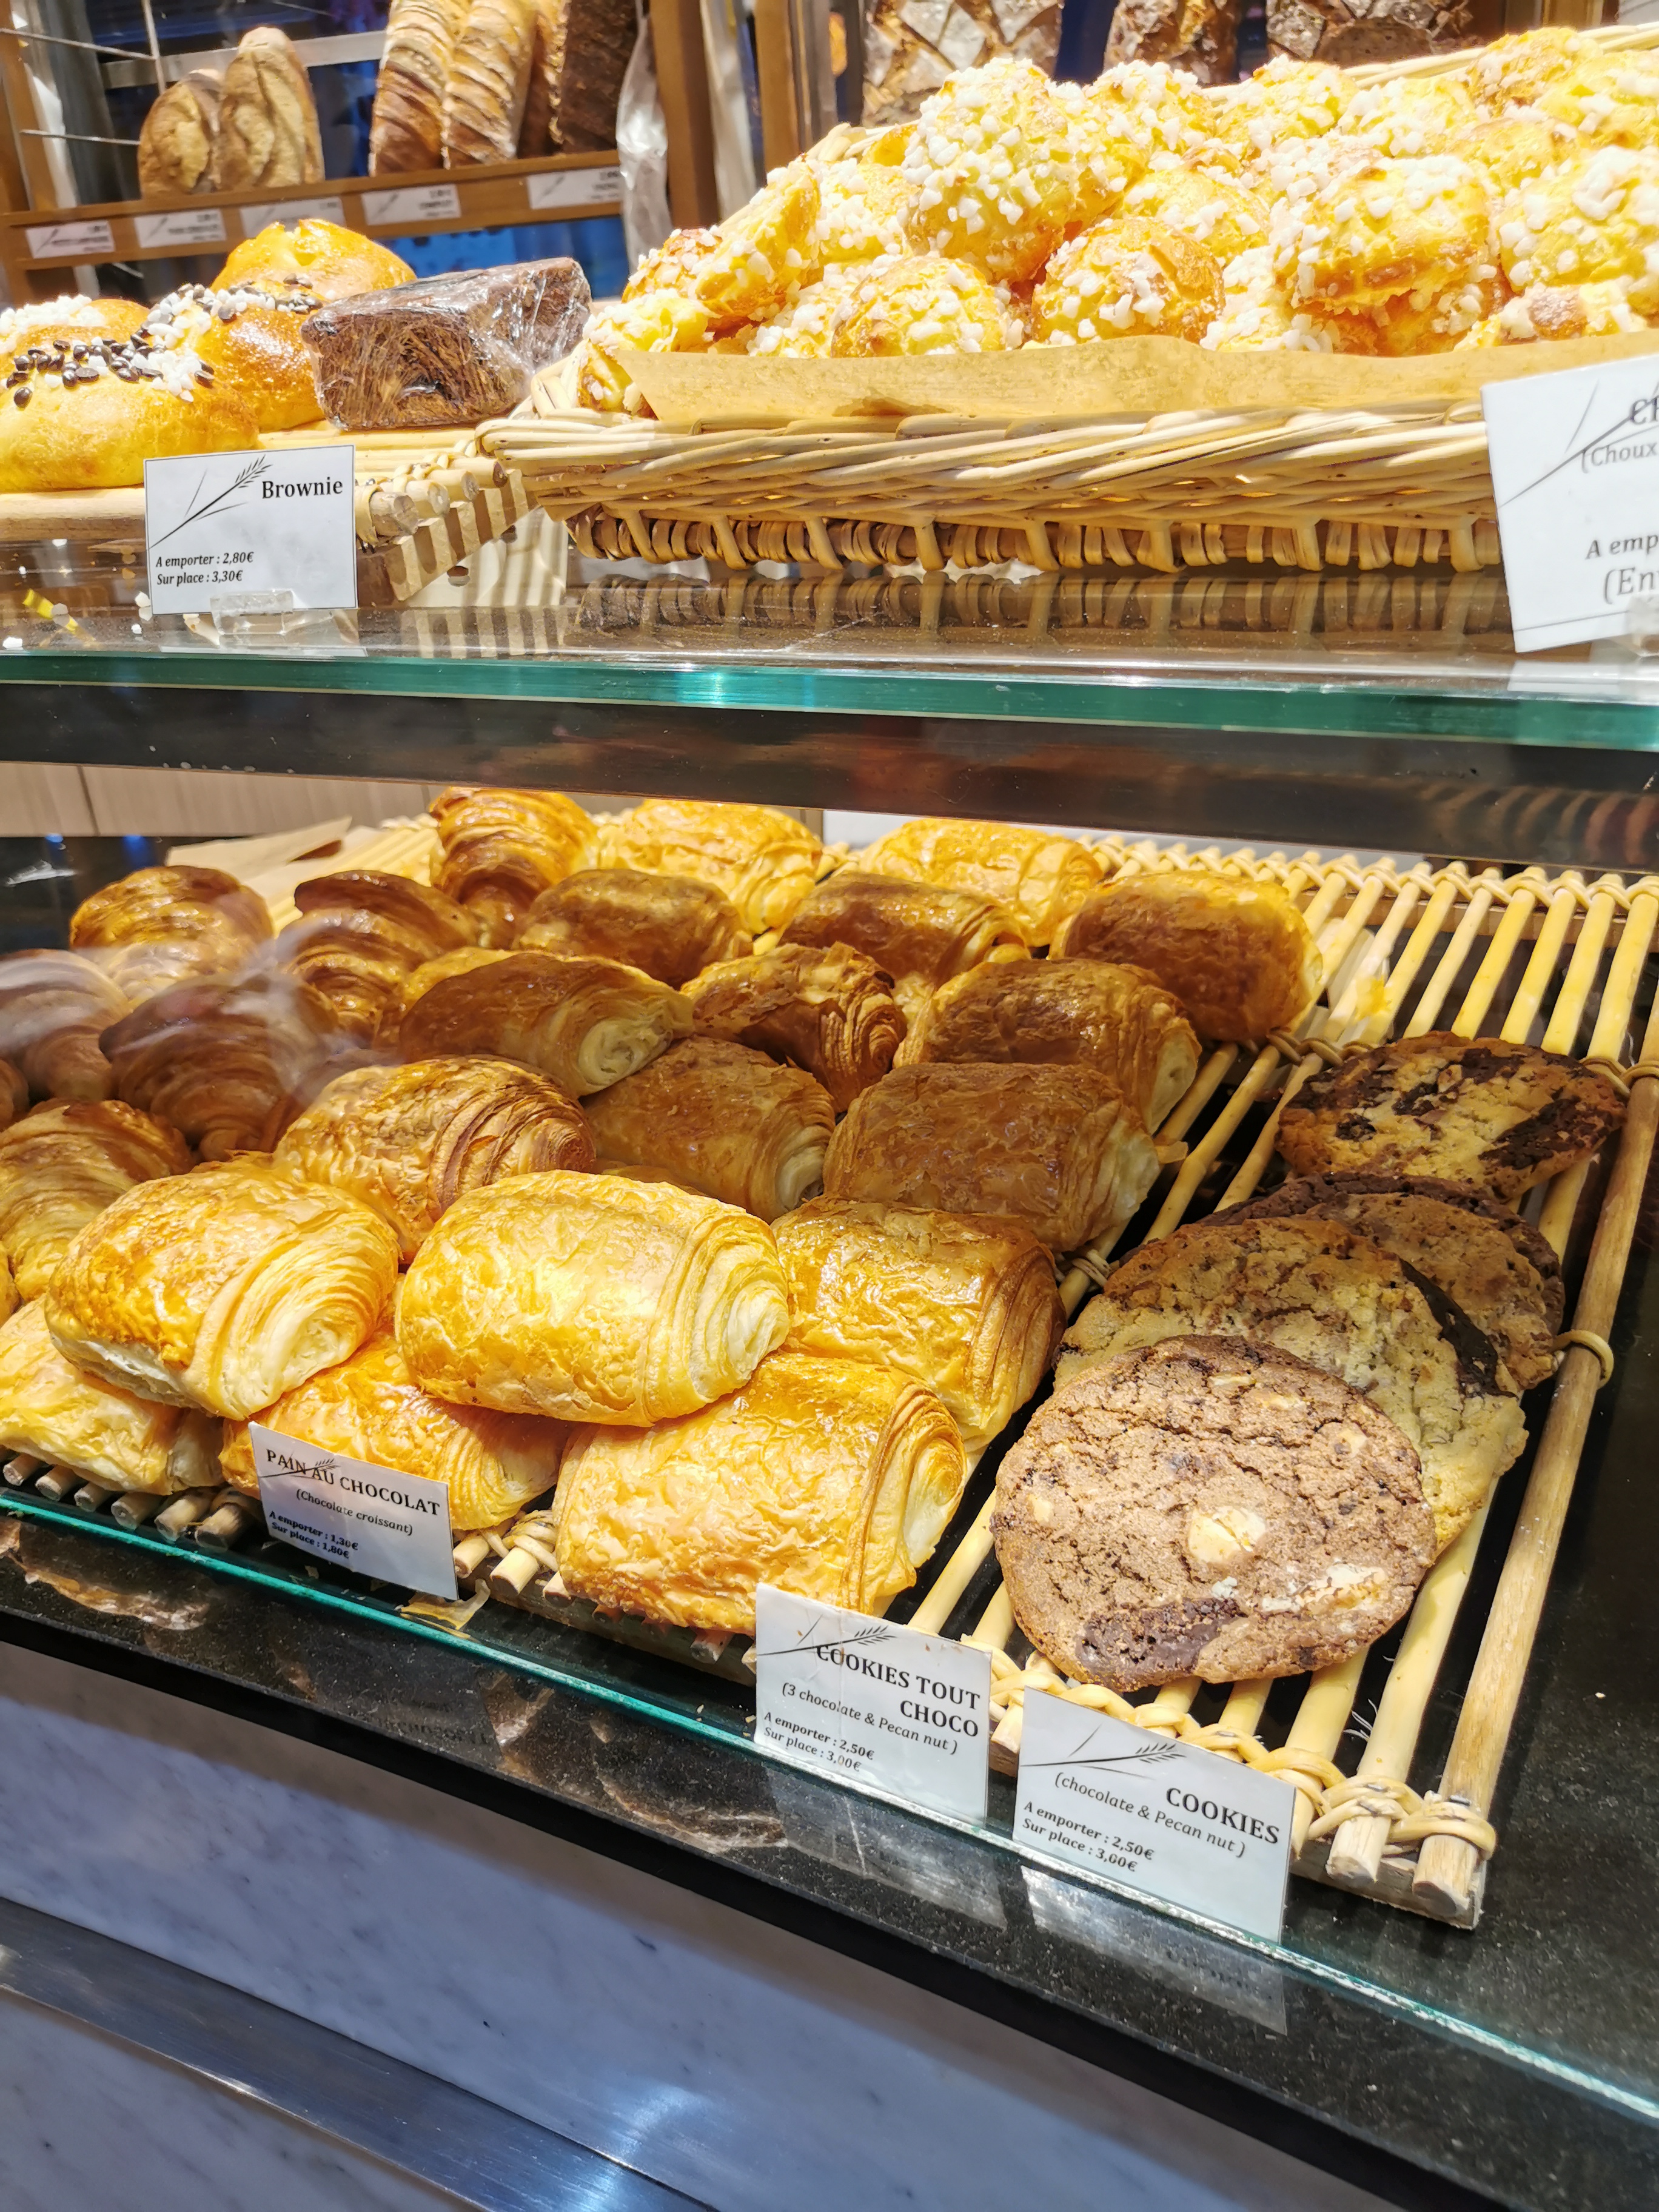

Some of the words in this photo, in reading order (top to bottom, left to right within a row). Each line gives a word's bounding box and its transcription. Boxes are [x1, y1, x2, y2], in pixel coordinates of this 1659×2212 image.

[1581, 442, 1658, 474] (Choux
[262, 477, 343, 499] Brownie
[156, 557, 163, 568] A
[166, 554, 215, 569] emporter
[223, 552, 254, 565] 2,80€
[1584, 540, 1601, 560] A
[157, 574, 175, 585] Sur
[177, 572, 204, 587] place
[212, 570, 243, 583] 3,30€
[1603, 566, 1659, 605] (En
[267, 1449, 306, 1475] PAIN
[312, 1467, 334, 1484] AU
[340, 1476, 440, 1516] CHOCOLAT
[269, 1510, 276, 1519] A
[278, 1515, 323, 1537] emporter
[331, 1534, 358, 1550] 1,30€
[296, 1489, 353, 1517] (Chocolate
[356, 1512, 413, 1536] croissant)
[272, 1522, 287, 1533] Sur
[290, 1530, 315, 1545] place
[323, 1543, 349, 1559] 1,80€
[817, 1646, 910, 1688] COOKIES
[916, 1675, 980, 1710] TOUT
[764, 1712, 772, 1722] A
[775, 1717, 831, 1743] emporter
[839, 1739, 875, 1760] 2,50€
[782, 1682, 796, 1697] (3
[799, 1689, 861, 1720] chocolate
[864, 1713, 875, 1726] &
[879, 1717, 919, 1741] Pecan
[923, 1735, 949, 1750] nut
[900, 1700, 979, 1737] CHOCO
[763, 1727, 785, 1741] Sur
[785, 1737, 817, 1755] place
[826, 1751, 862, 1772] 3,00€
[1024, 1801, 1033, 1813] A
[1036, 1808, 1102, 1840] emporter
[1111, 1836, 1155, 1860] 2,50€
[1055, 1772, 1134, 1814] (chocolate
[1138, 1805, 1150, 1820] &
[1154, 1810, 1202, 1840] Pecan
[1206, 1832, 1235, 1852] nut
[1165, 1787, 1280, 1845] COOKIES
[1022, 1818, 1047, 1835] Sur
[1048, 1831, 1085, 1852] place
